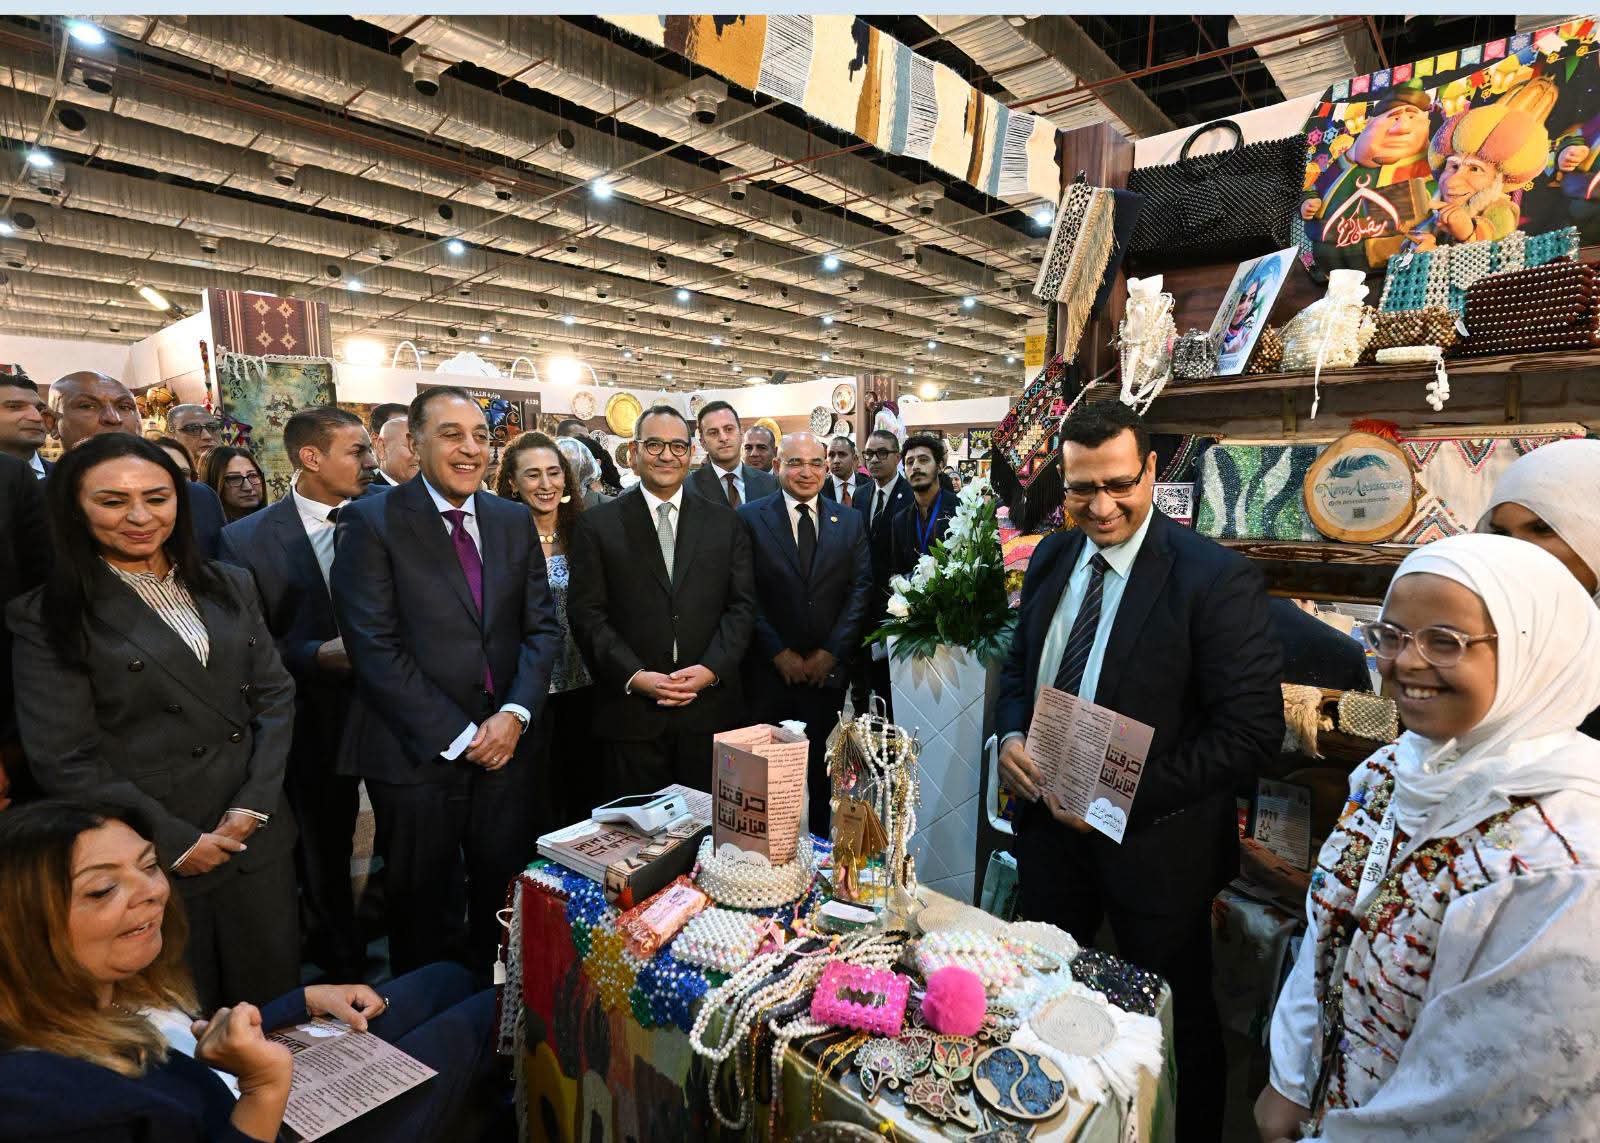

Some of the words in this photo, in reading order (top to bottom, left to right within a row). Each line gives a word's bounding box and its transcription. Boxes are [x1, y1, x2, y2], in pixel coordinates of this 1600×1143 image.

[1336, 206, 1360, 248] كريم
[1351, 216, 1388, 244] رمضان
[1105, 744, 1142, 776] حرفتنا
[718, 779, 766, 814] حرفتنا
[1371, 837, 1389, 856] تراثنا
[1363, 862, 1382, 883] تراثنا
